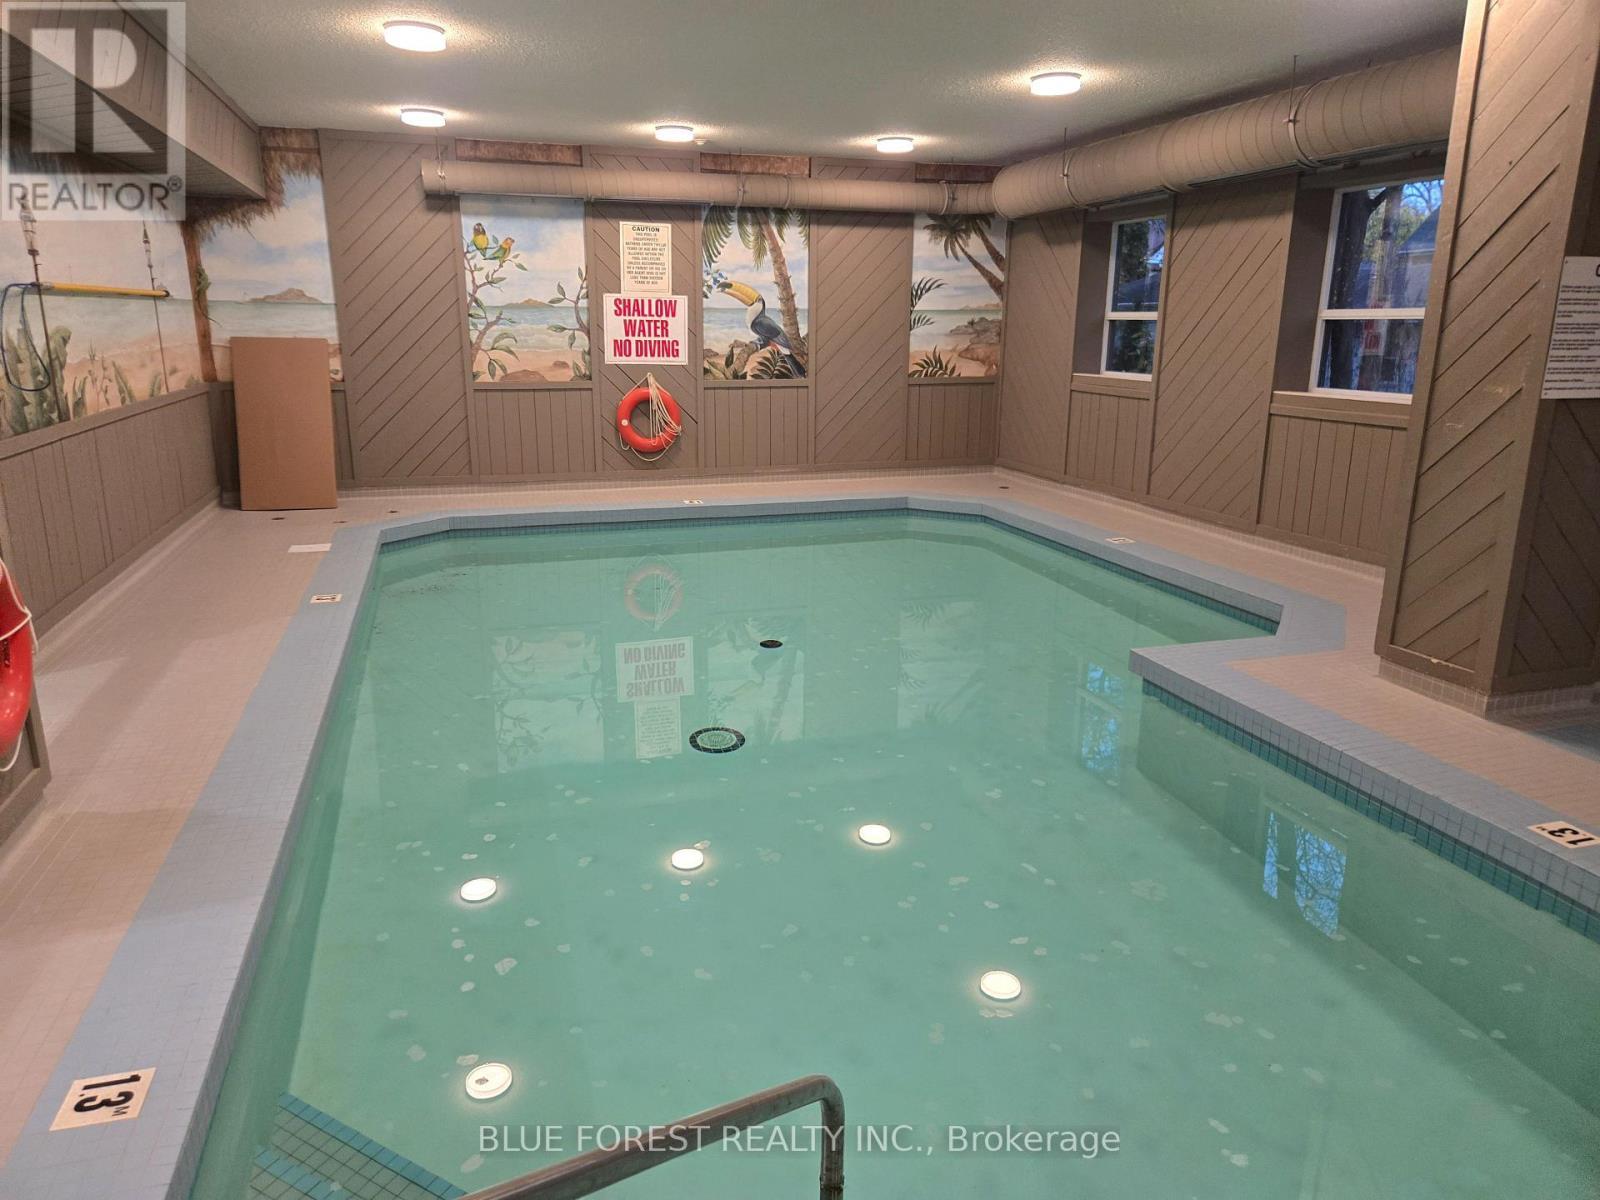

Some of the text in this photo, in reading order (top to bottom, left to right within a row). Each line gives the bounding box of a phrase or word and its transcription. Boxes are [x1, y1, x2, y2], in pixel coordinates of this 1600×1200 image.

[613, 298, 677, 318] SHALLOW
[623, 319, 669, 338] WATER
[613, 339, 679, 358] NO DIVING
